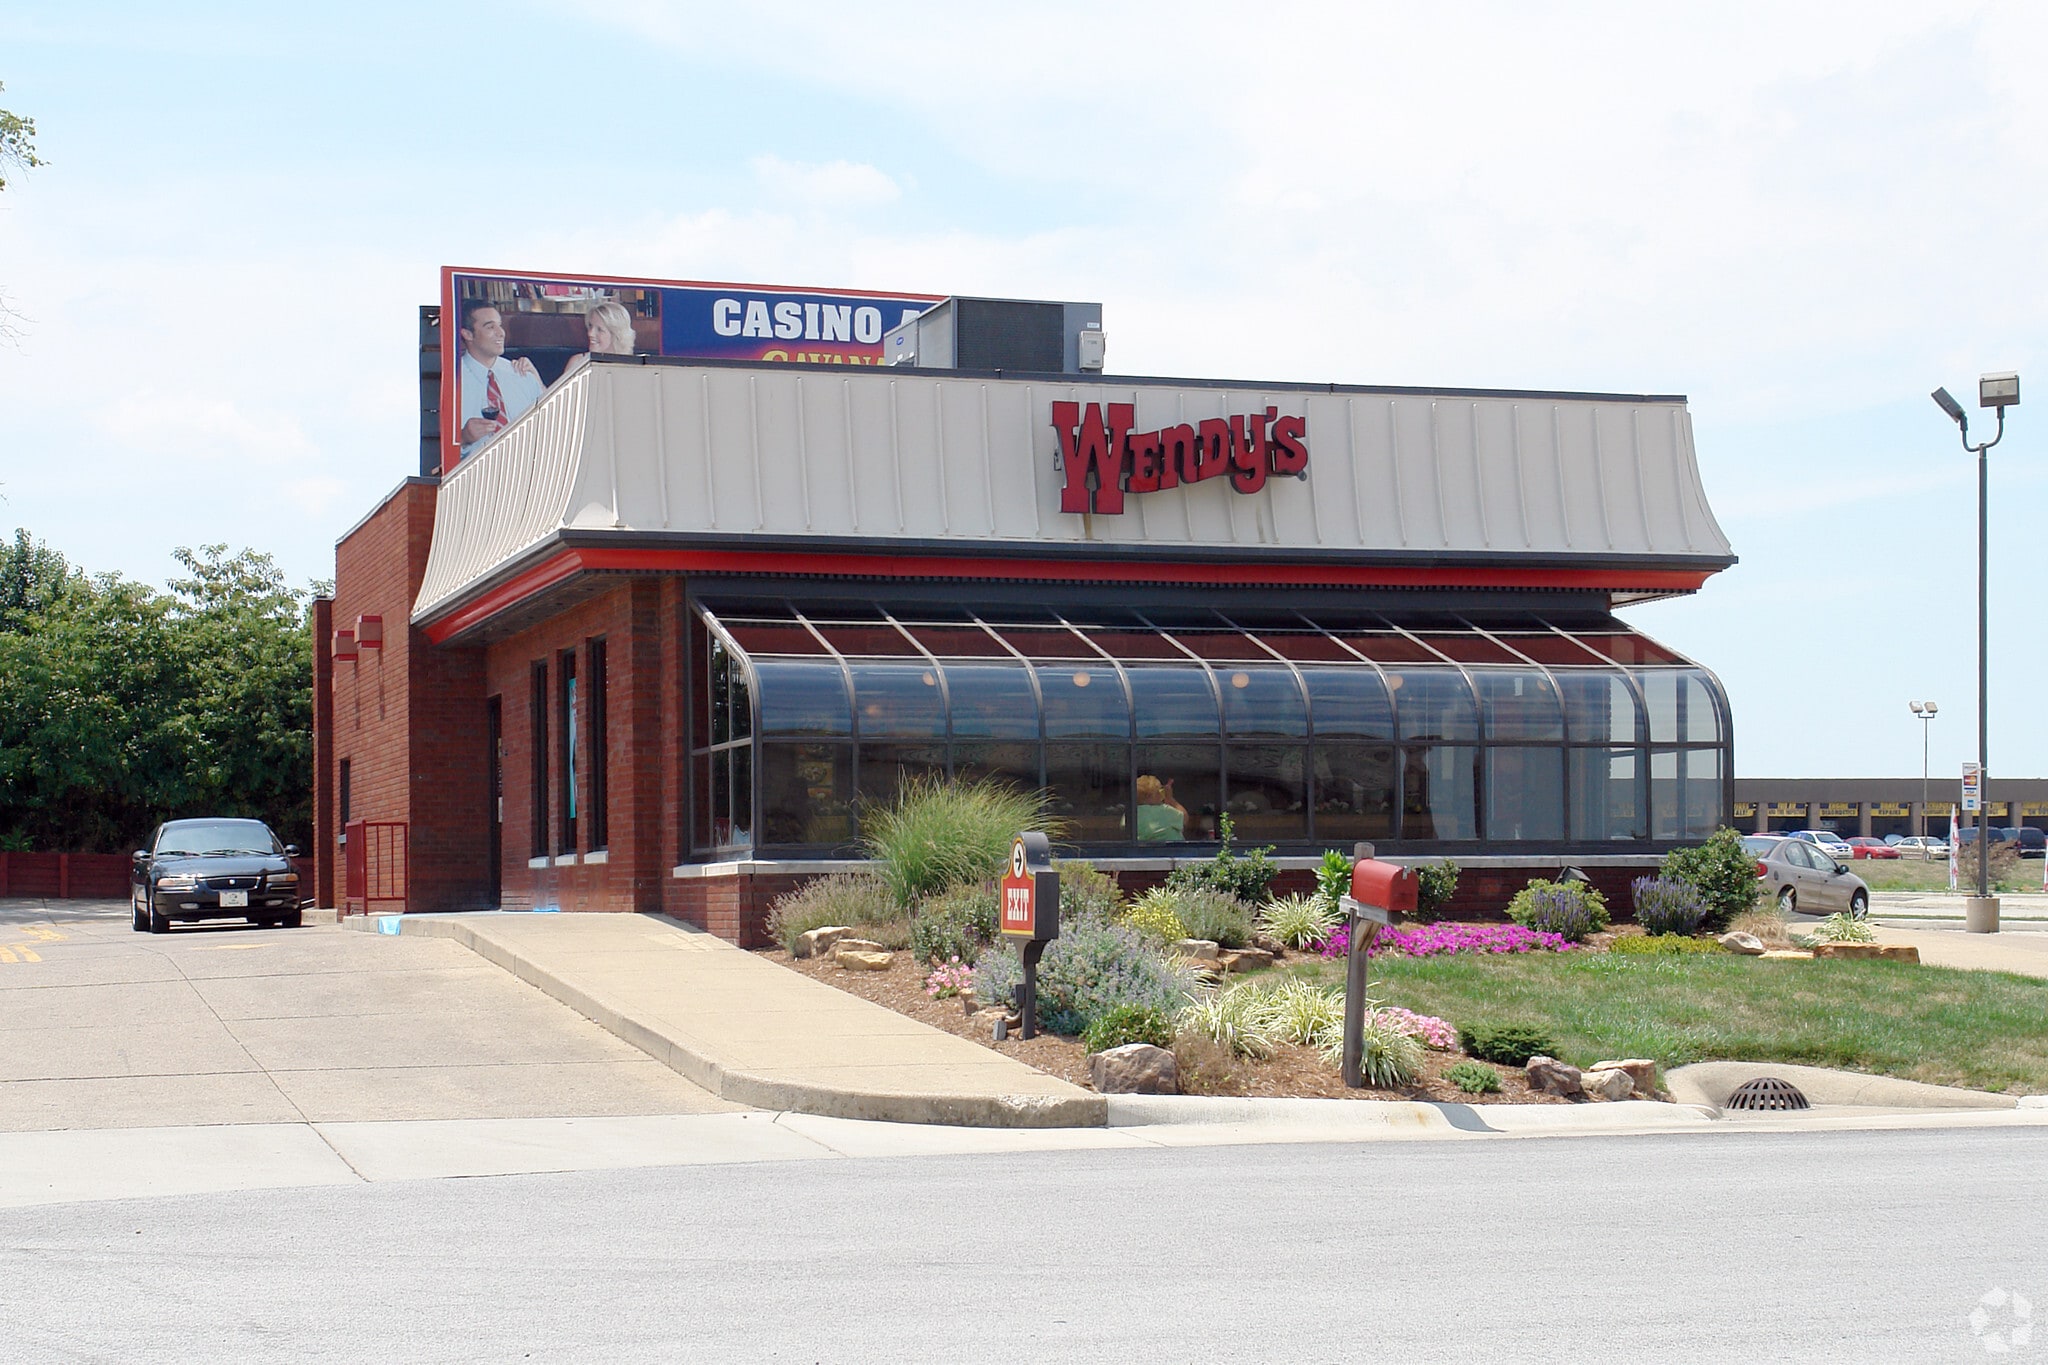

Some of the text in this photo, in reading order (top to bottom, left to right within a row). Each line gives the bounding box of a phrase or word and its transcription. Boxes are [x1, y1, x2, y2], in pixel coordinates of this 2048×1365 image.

[713, 298, 882, 344] CASINO
[1049, 400, 1308, 515] Wendy's
[1007, 888, 1029, 921] EXIT
